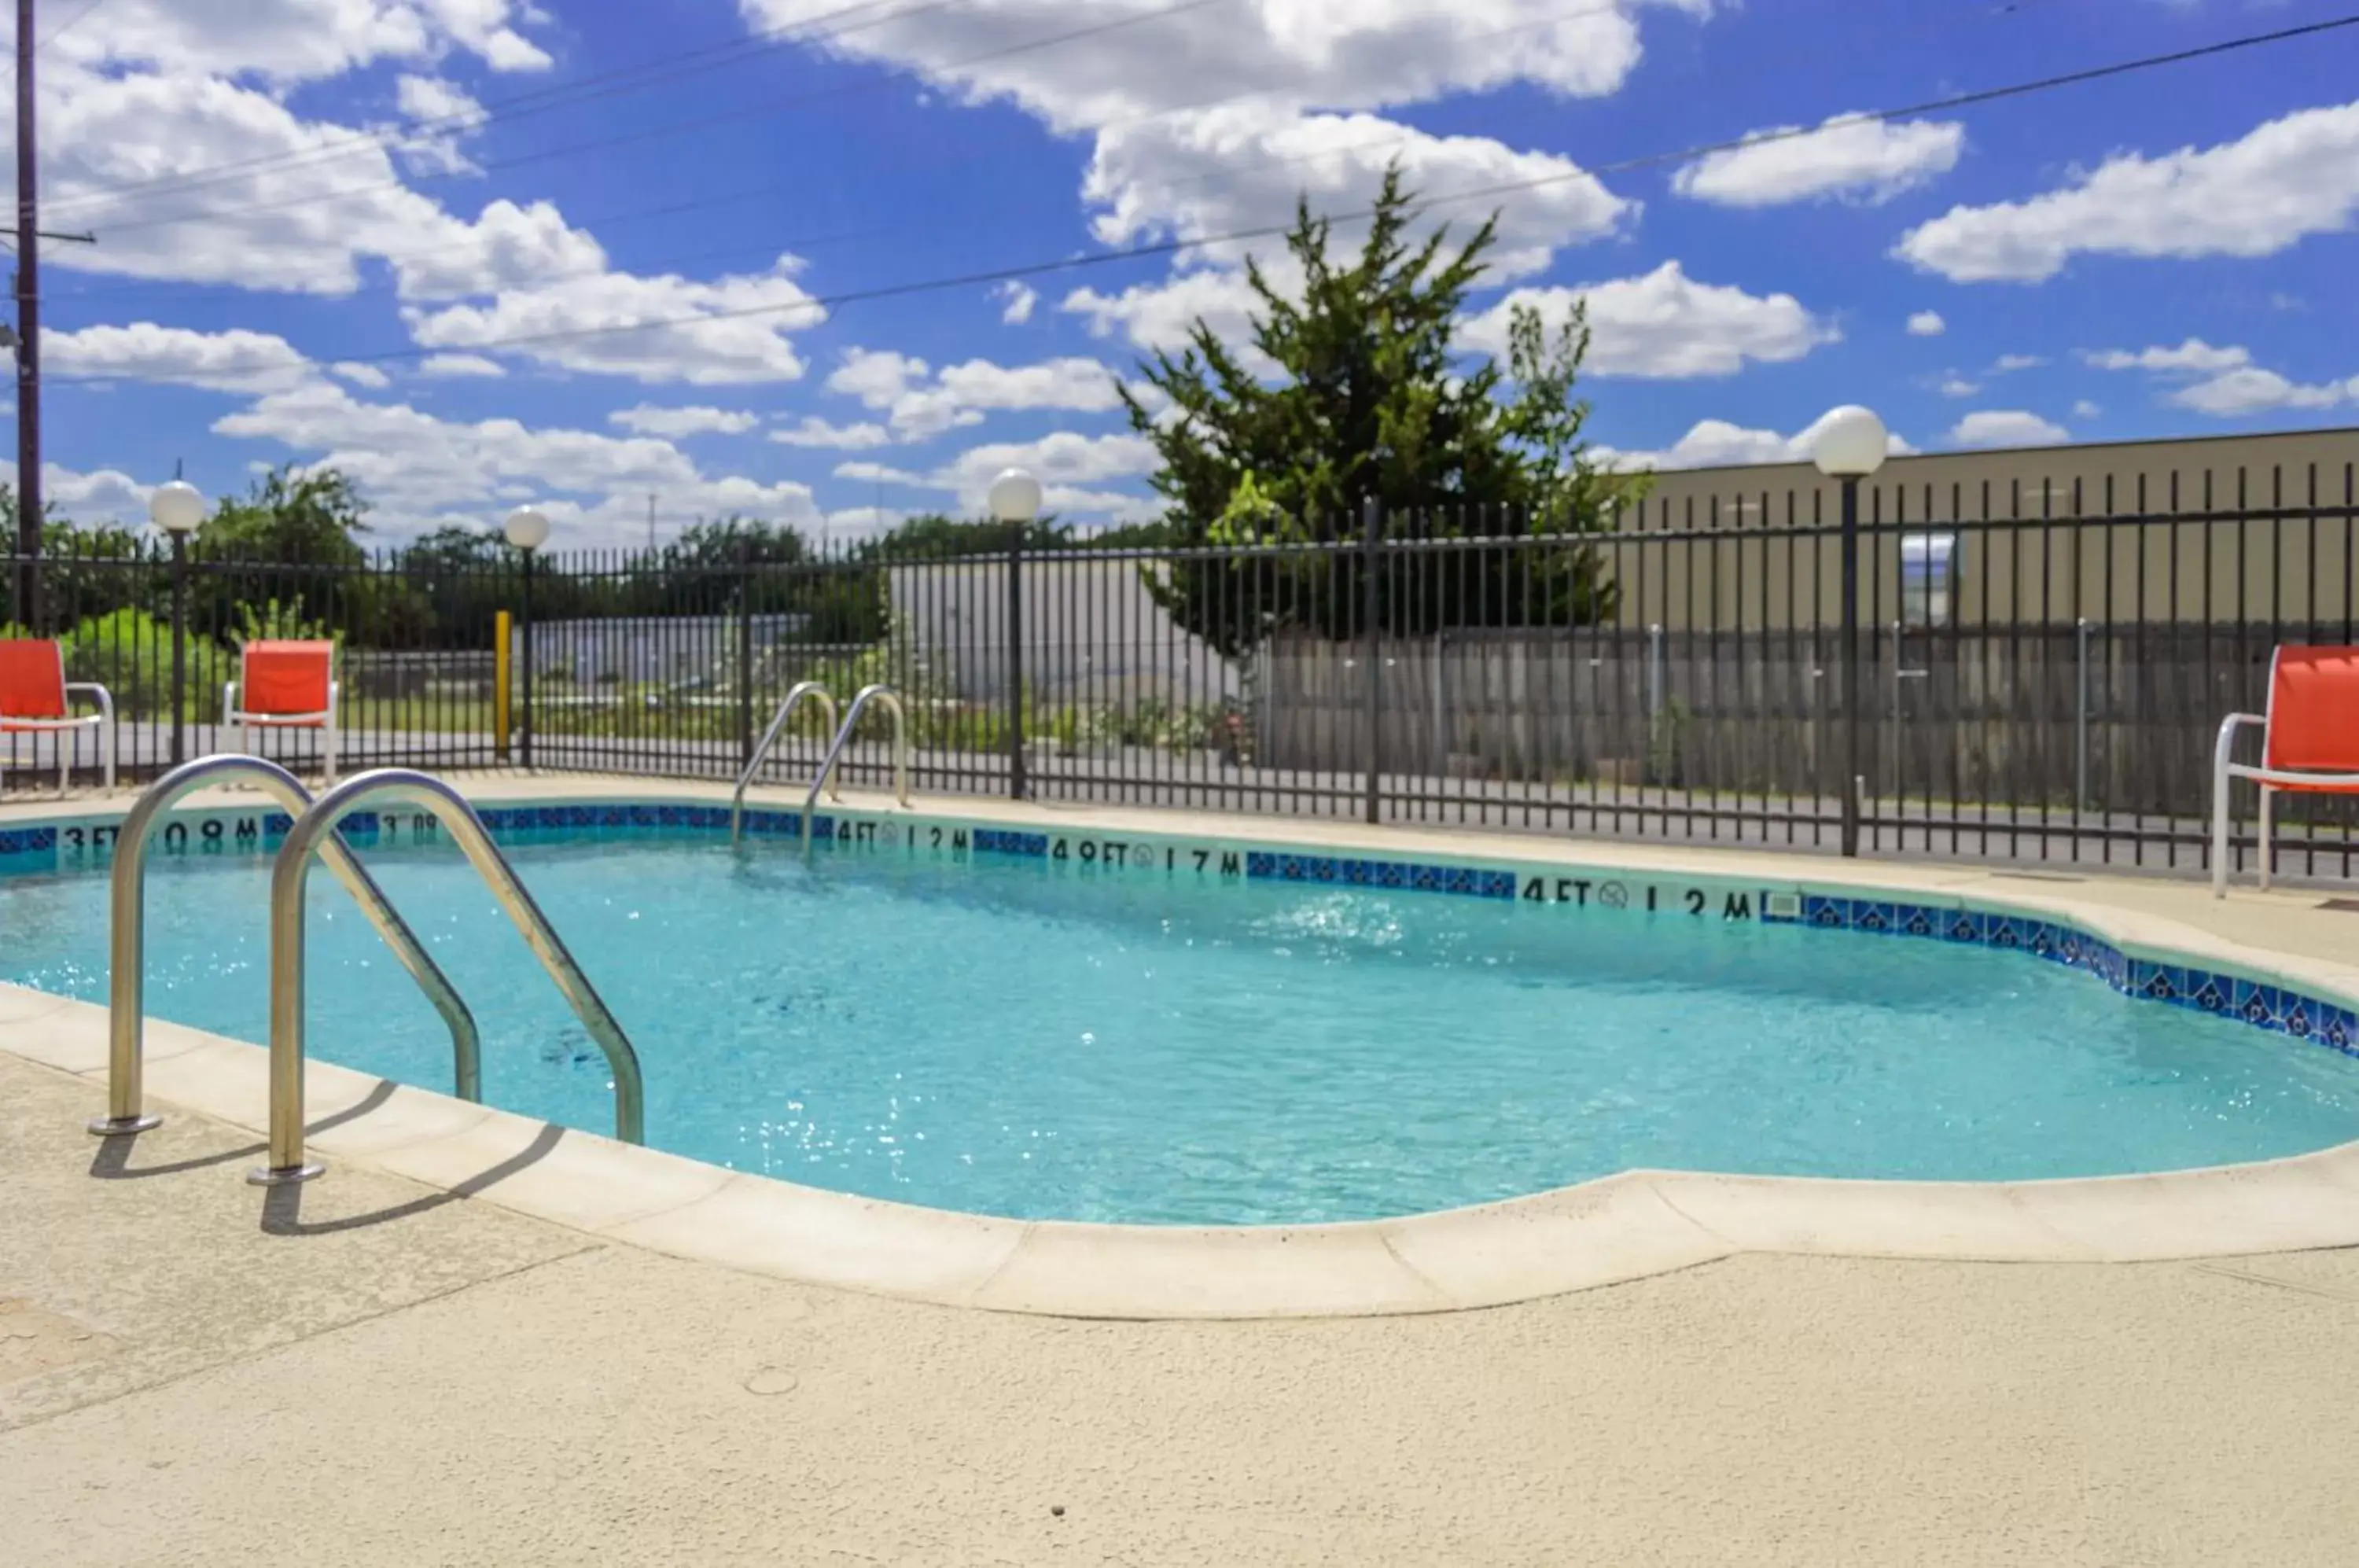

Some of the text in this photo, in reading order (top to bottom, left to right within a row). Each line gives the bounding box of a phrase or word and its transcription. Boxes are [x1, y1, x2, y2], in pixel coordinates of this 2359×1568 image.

[856, 822, 877, 842] FT
[1103, 841, 1128, 867] FT
[1220, 851, 1240, 876] M
[1522, 877, 1544, 902] 4
[1556, 878, 1591, 907] FT
[1723, 892, 1750, 919] M
